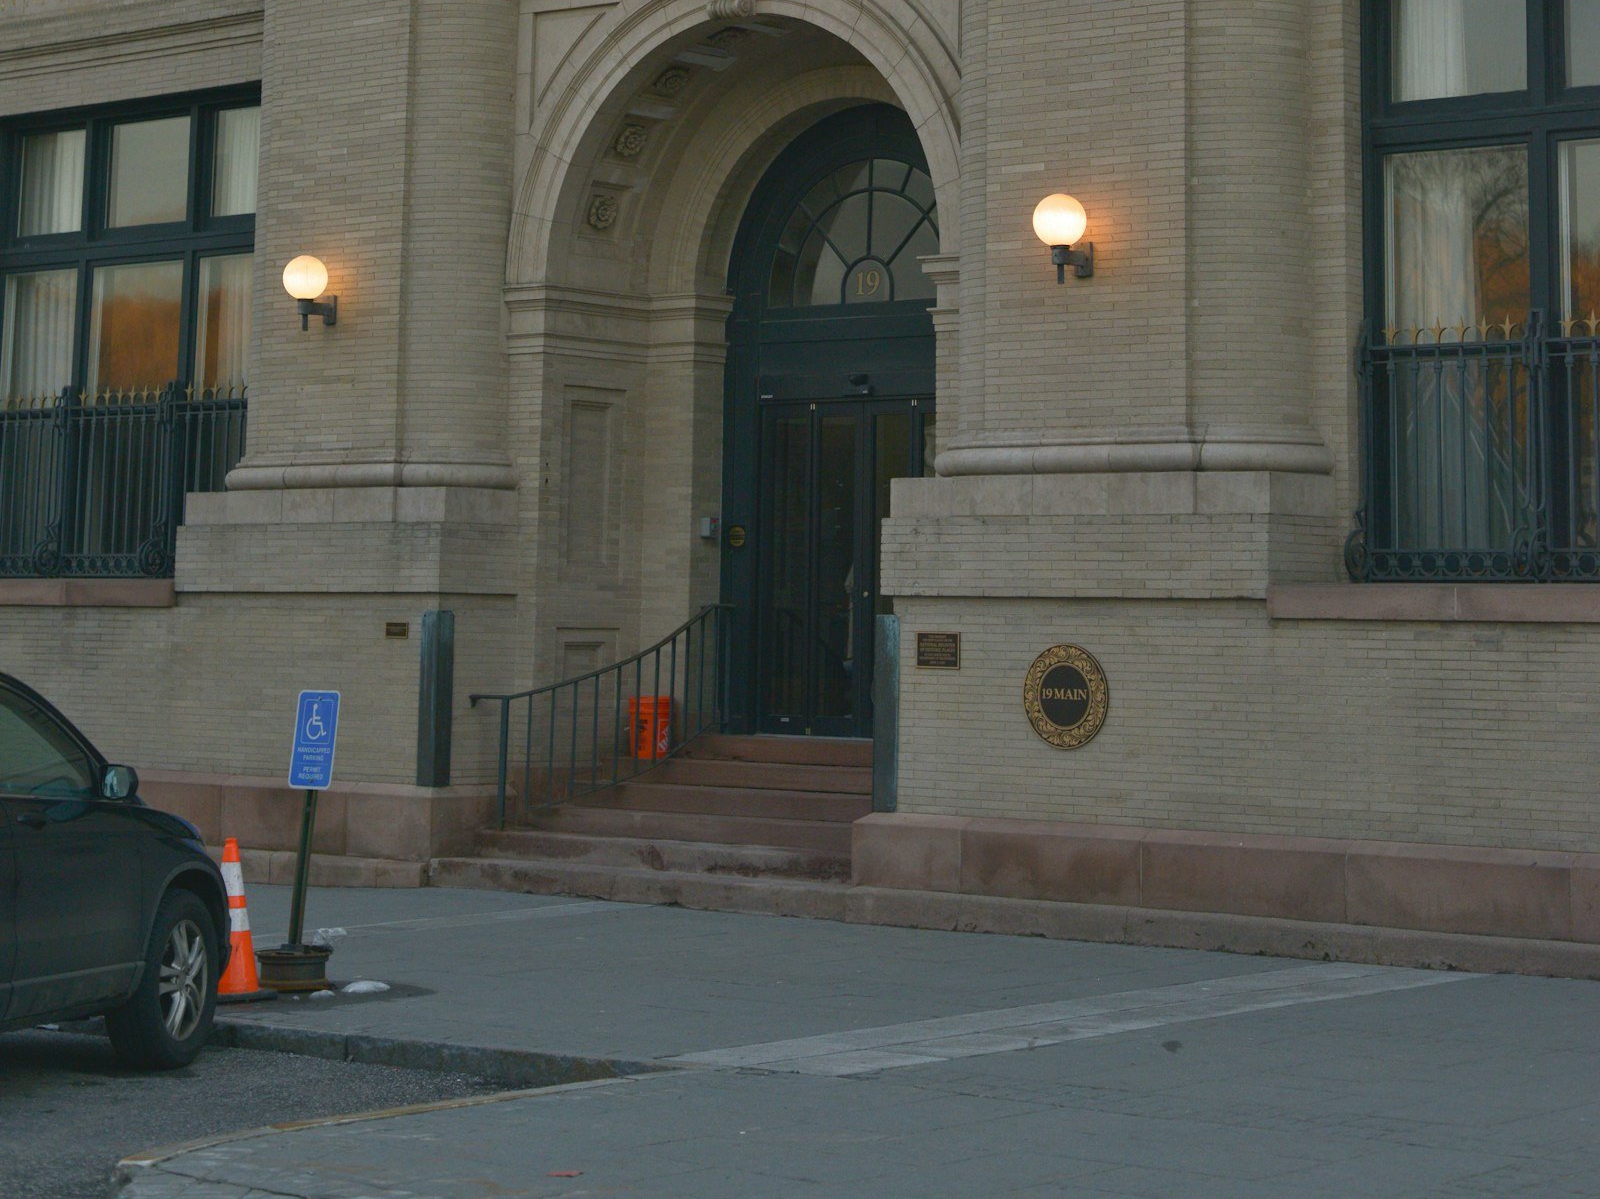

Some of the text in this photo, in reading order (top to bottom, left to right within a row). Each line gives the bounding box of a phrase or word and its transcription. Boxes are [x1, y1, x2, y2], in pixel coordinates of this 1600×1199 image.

[855, 270, 881, 296] 19
[1041, 688, 1087, 701] 19 MAIN
